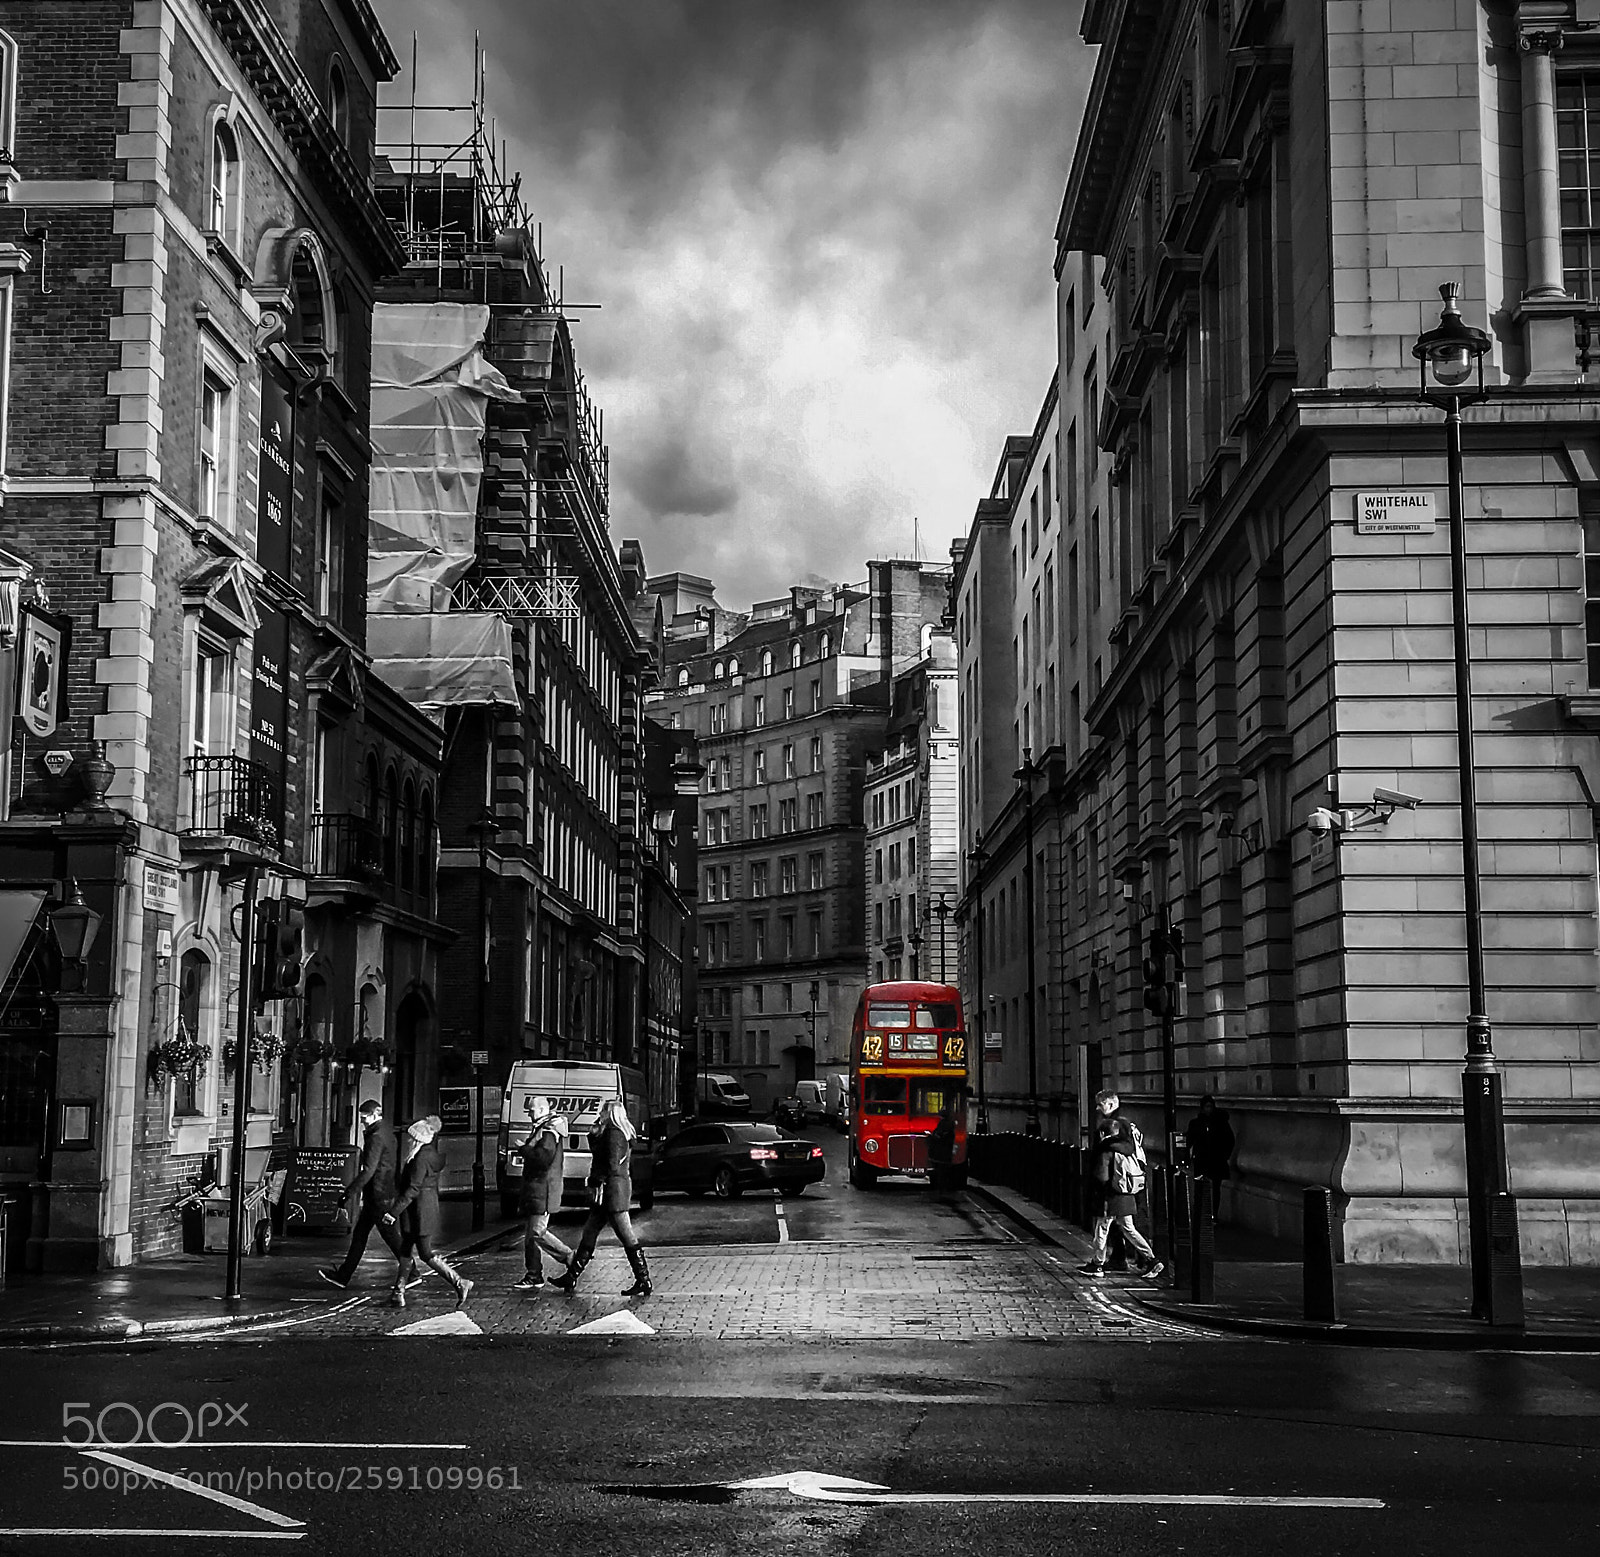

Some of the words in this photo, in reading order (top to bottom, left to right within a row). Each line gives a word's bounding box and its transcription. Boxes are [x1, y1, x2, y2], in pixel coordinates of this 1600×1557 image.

[260, 437, 290, 475] CLARENCE
[1365, 496, 1428, 507] WHITEHALL
[267, 501, 282, 526] 1862
[1365, 509, 1387, 520] SW1
[890, 1035, 901, 1047] 15
